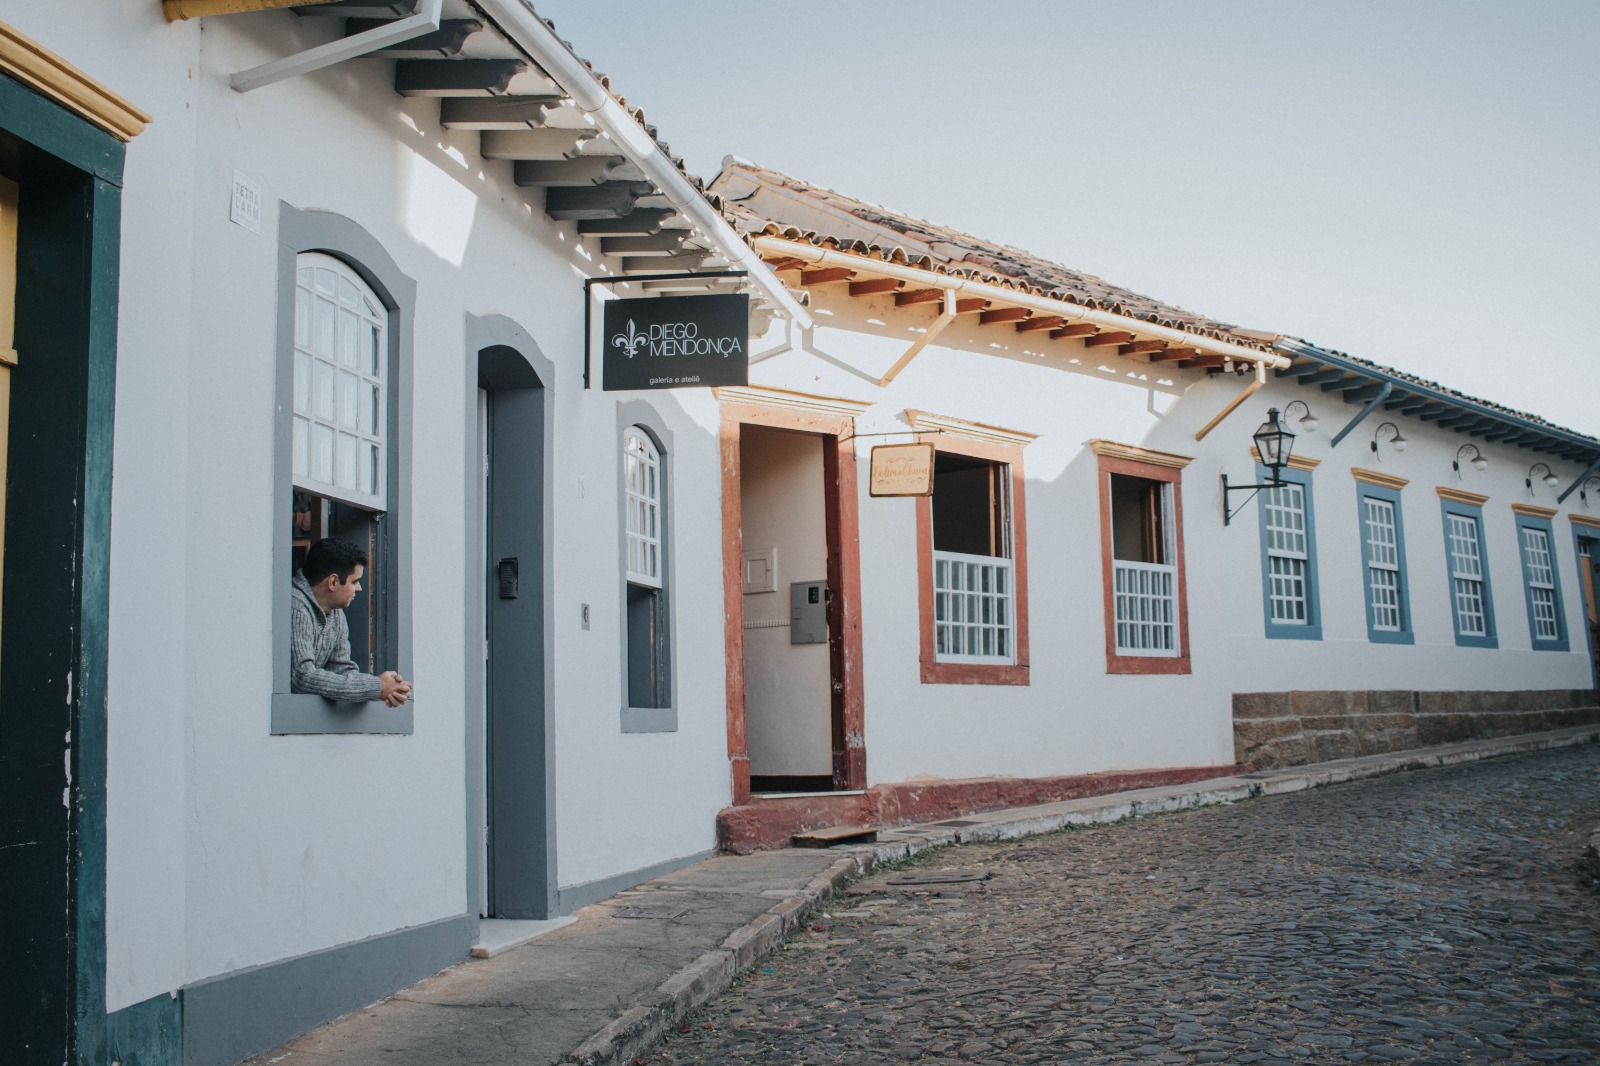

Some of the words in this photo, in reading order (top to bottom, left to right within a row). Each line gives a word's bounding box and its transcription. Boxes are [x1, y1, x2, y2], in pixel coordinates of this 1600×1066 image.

[235, 181, 259, 206] TETRA
[650, 322, 698, 340] DIEGO
[649, 337, 742, 358] MENDONÇA
[649, 376, 673, 386] galeria
